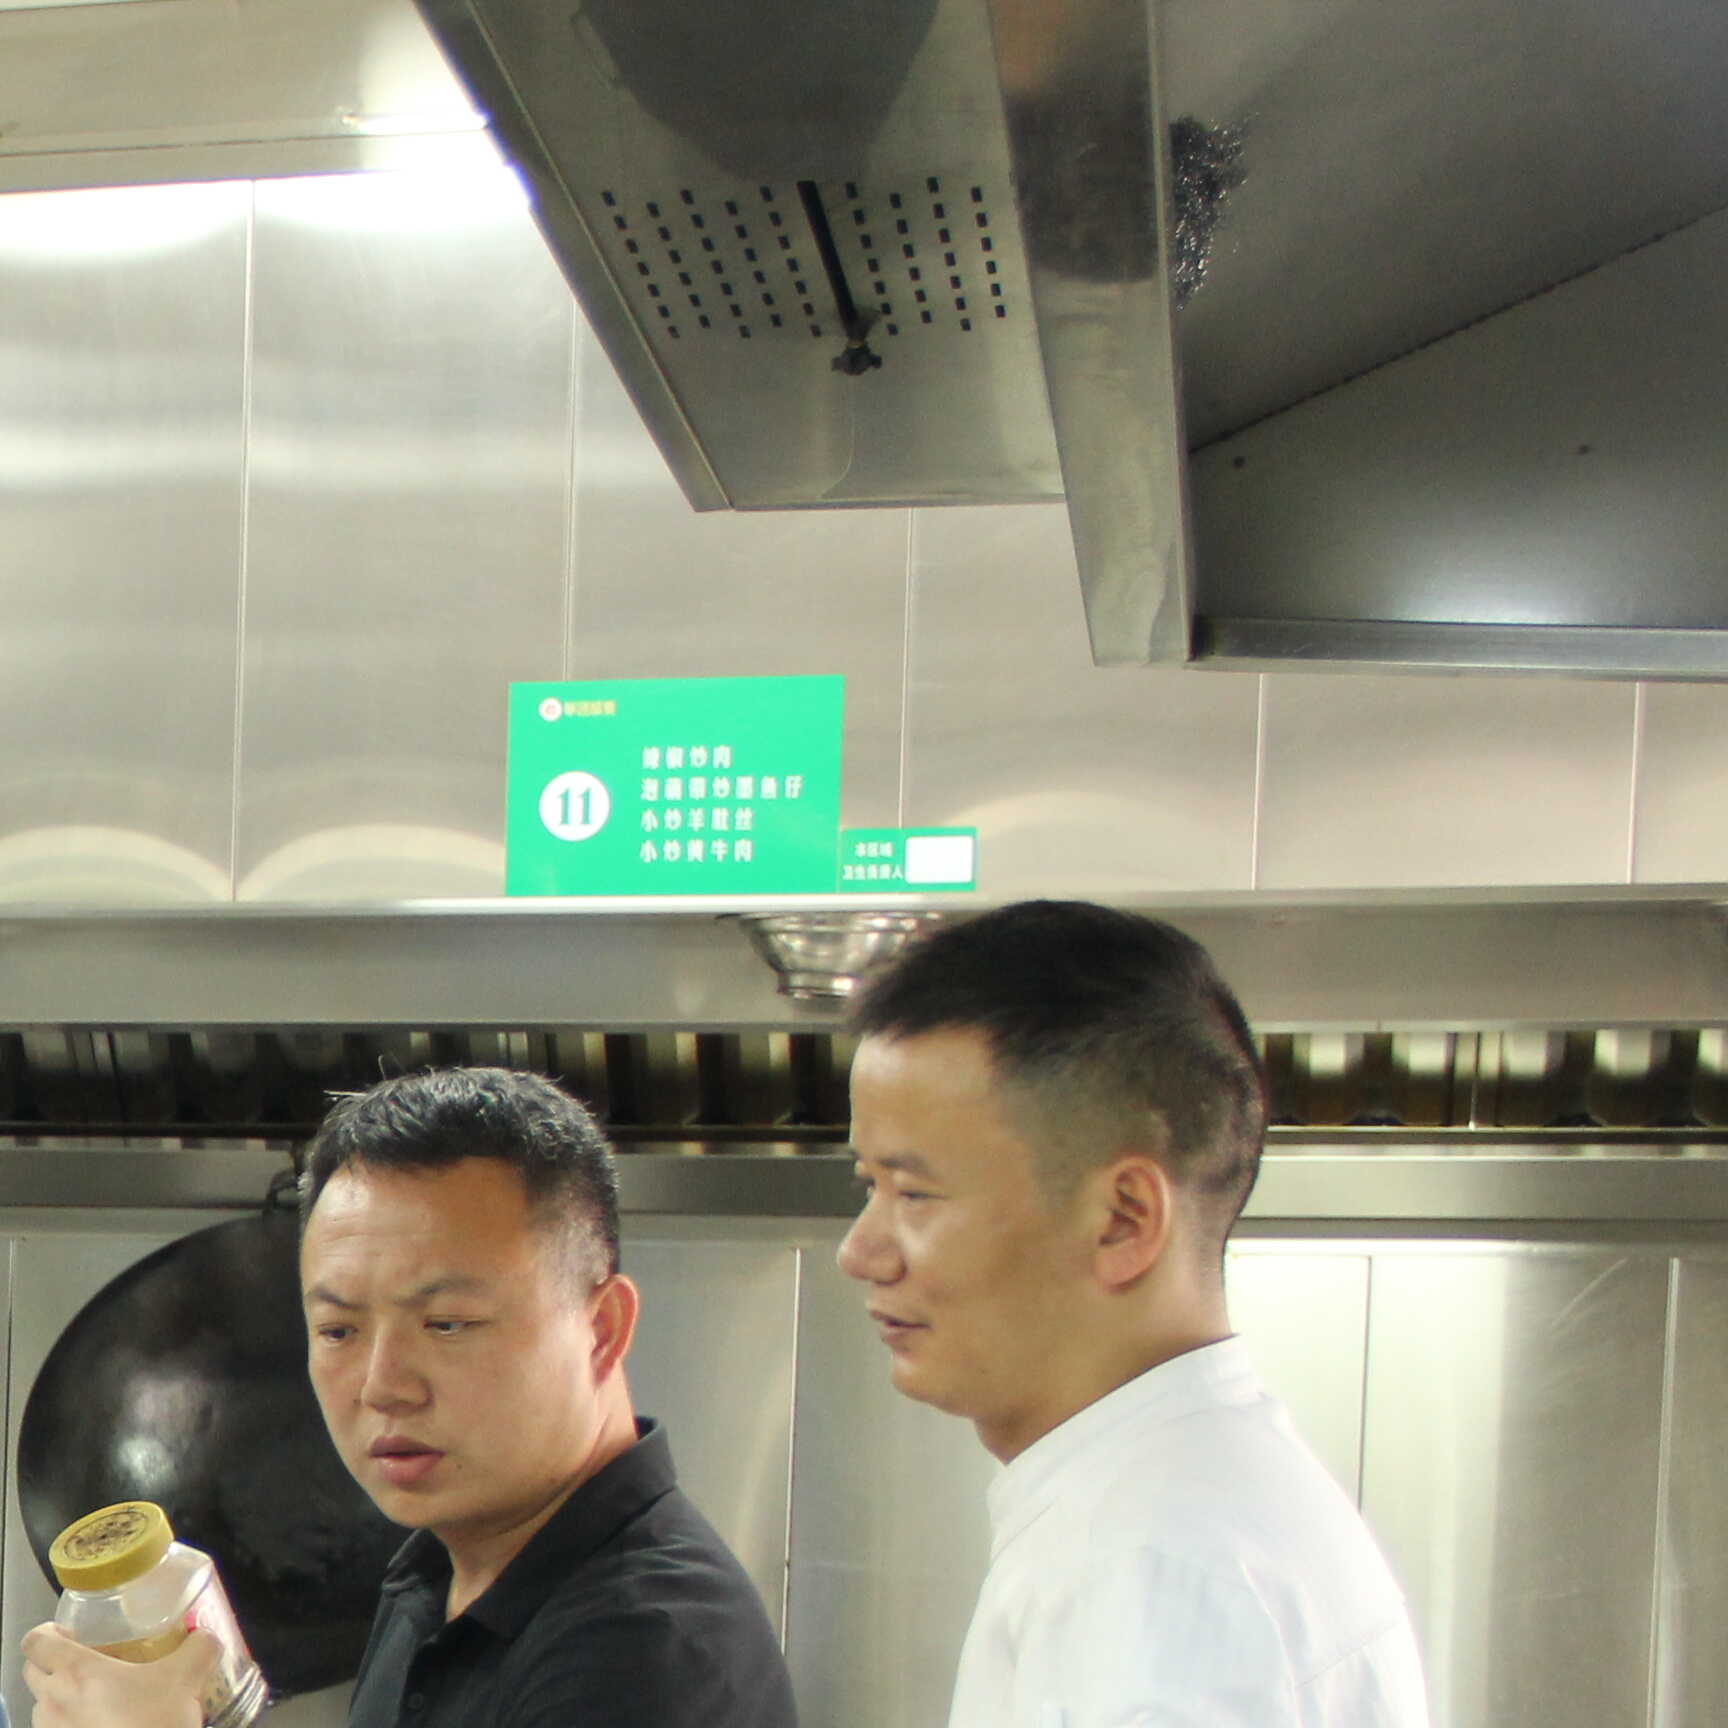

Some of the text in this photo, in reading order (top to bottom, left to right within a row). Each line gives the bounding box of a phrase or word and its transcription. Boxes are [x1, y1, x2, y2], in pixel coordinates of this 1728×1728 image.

[556, 787, 592, 826] 11
[640, 838, 754, 863] 小炒黄牛肉
